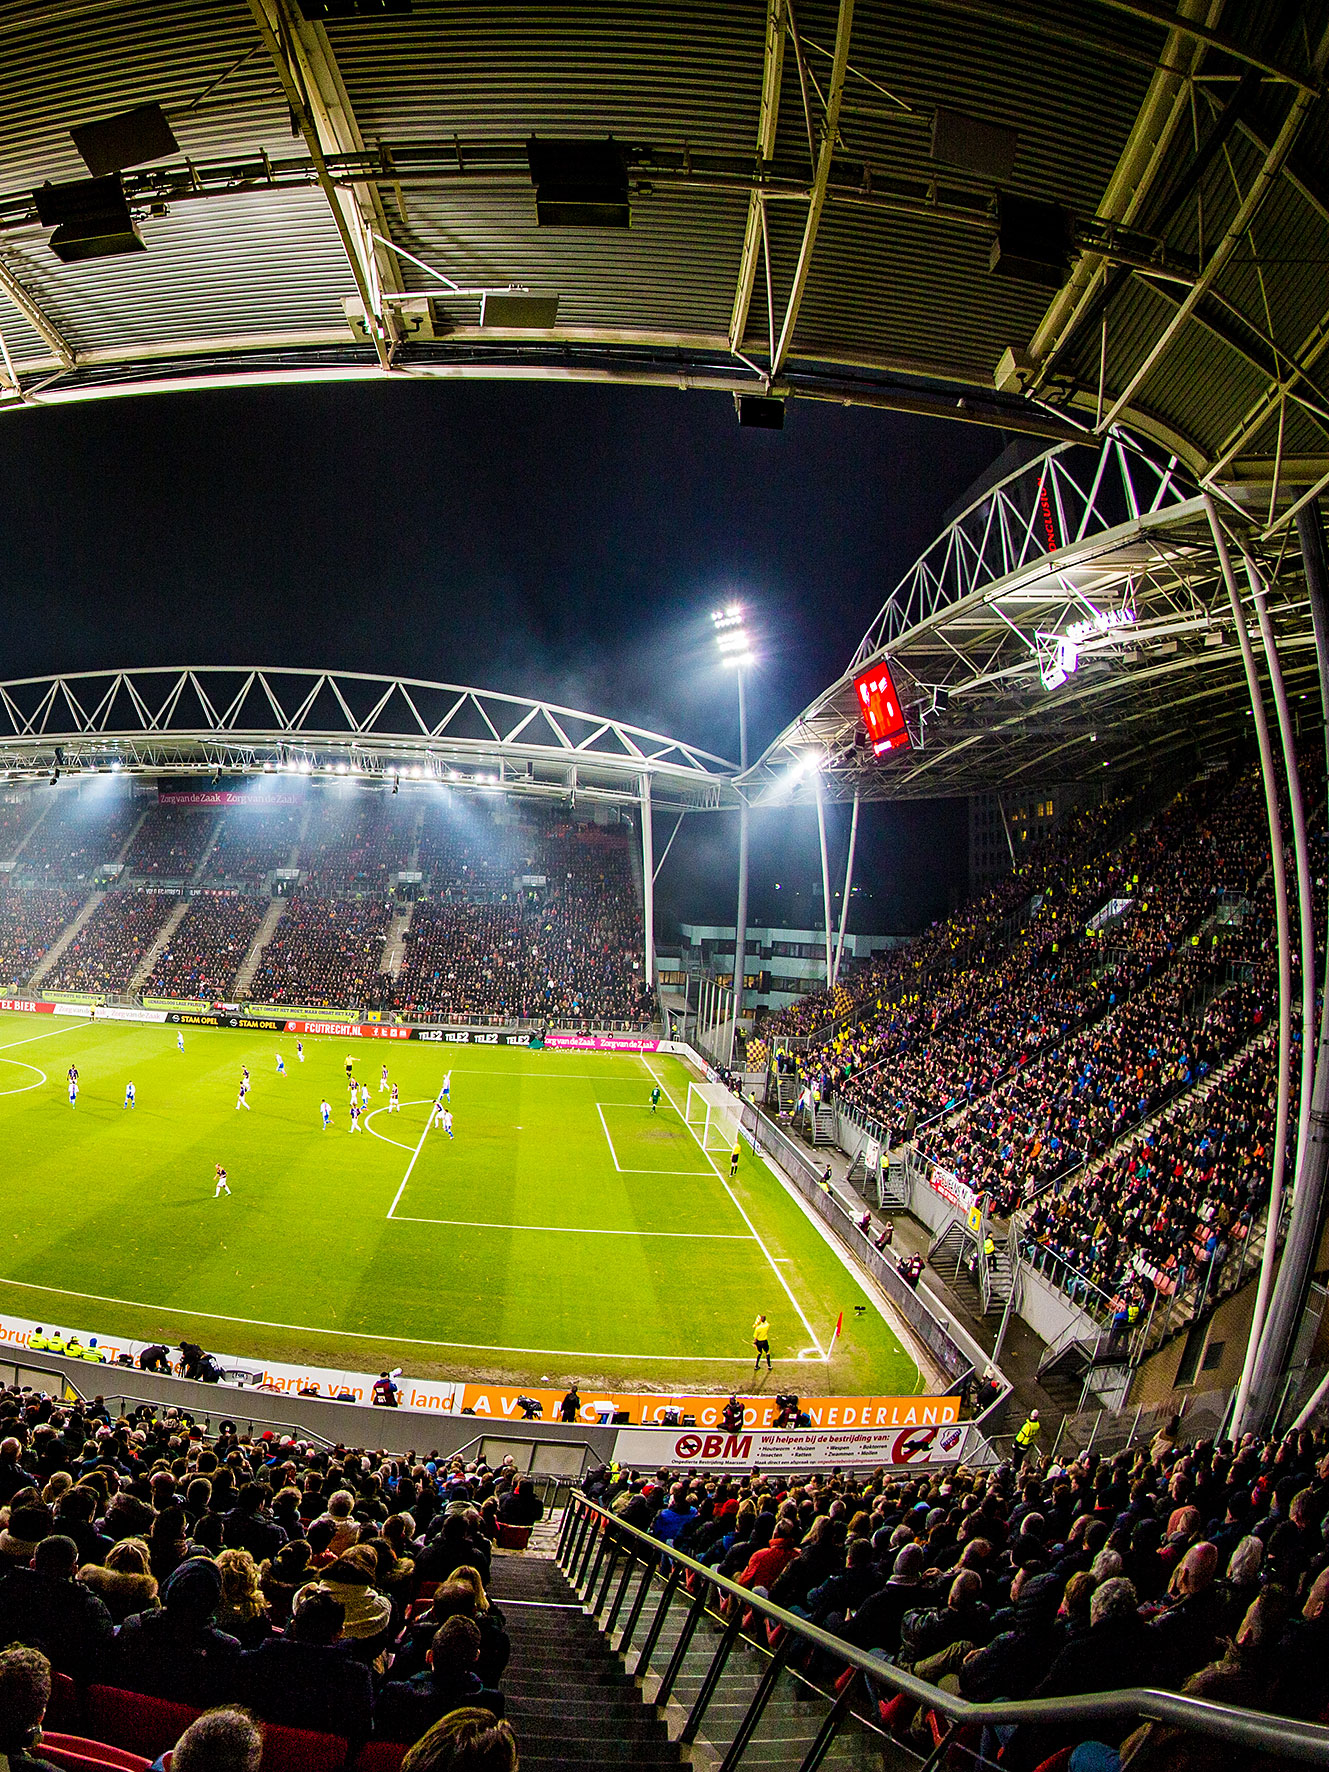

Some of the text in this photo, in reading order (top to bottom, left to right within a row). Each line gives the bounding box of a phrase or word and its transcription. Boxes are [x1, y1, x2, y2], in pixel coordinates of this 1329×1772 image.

[1037, 477, 1057, 552] ONCLUSION
[161, 795, 176, 804] Zorg
[191, 794, 200, 802] de
[200, 793, 221, 802] Zaak
[226, 794, 246, 804] Zorg
[14, 1000, 37, 1012] BIER
[180, 1015, 218, 1025] STAM OPEL
[238, 1019, 277, 1029] STAM OPEL
[419, 1030, 530, 1045] TELE2 TELE2 TELE2 TELE2
[579, 1038, 596, 1046] Zaak
[600, 1039, 614, 1049] Zorg
[328, 1384, 364, 1401] van
[410, 1389, 455, 1411] land
[808, 1405, 956, 1427] NEDERLAND
[761, 1435, 775, 1444] Wij
[776, 1435, 801, 1445] helpen
[805, 1435, 817, 1444] bij
[829, 1434, 872, 1444] bestrijding
[873, 1434, 890, 1442] van:
[675, 1433, 753, 1459] OBM
